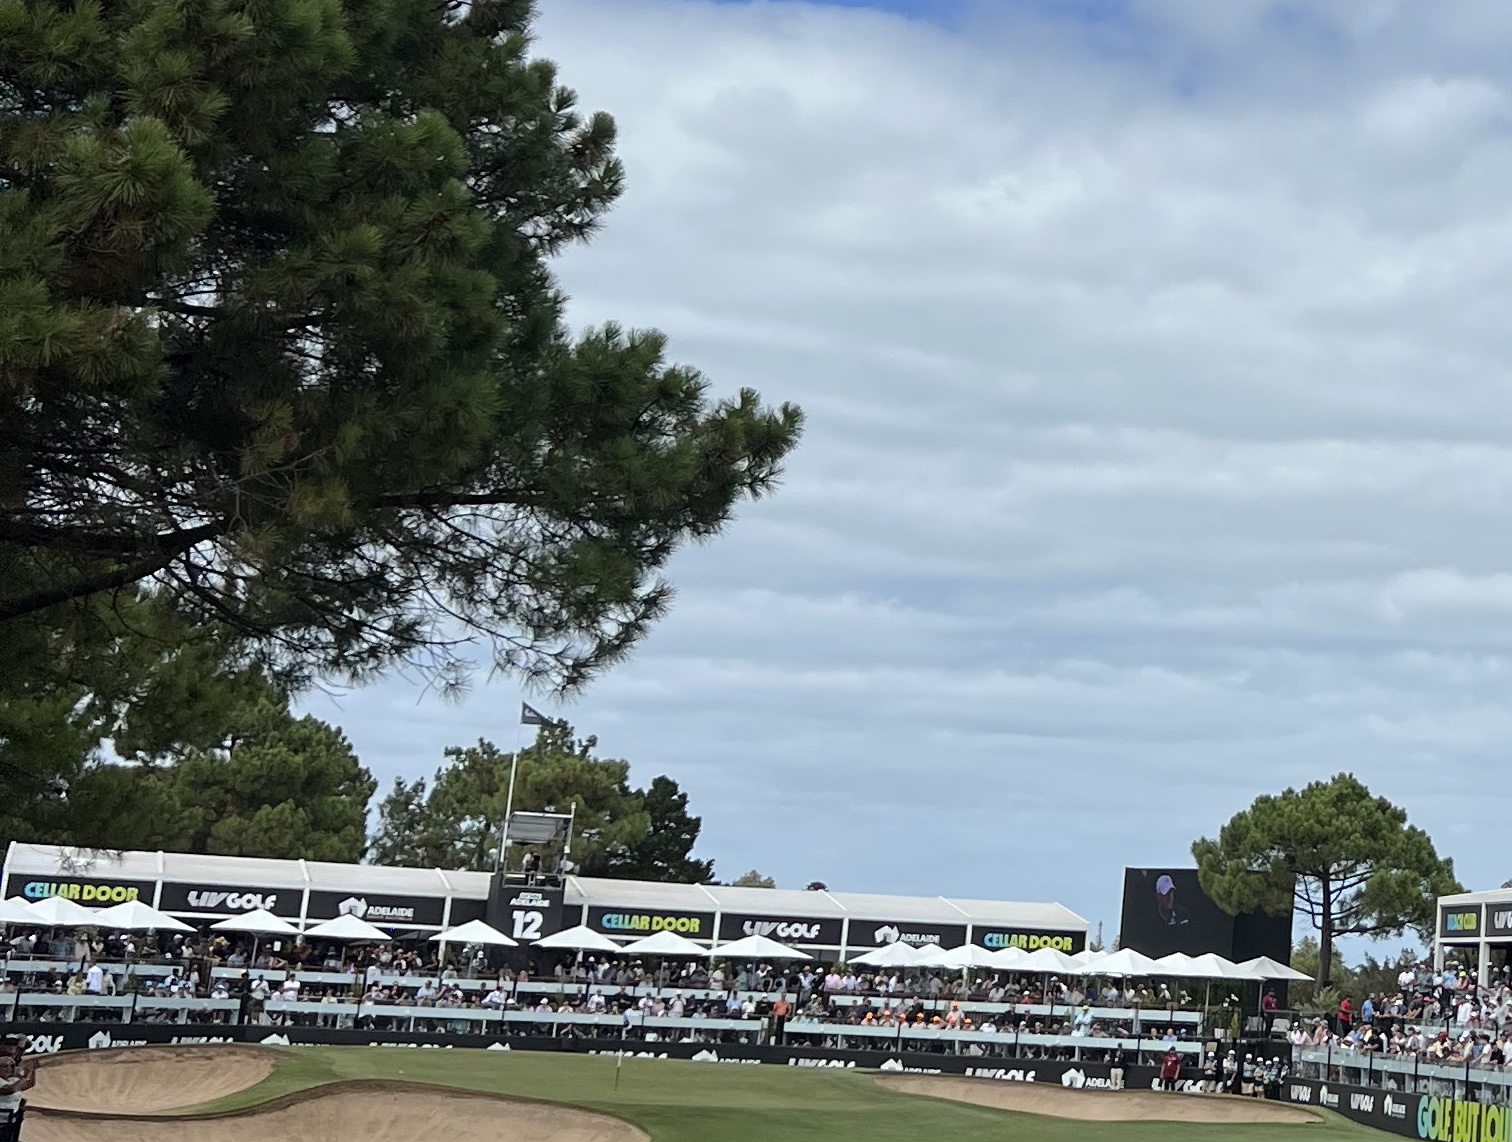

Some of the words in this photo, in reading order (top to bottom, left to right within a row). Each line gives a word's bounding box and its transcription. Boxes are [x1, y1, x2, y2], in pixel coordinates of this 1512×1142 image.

[24, 882, 80, 900] CELLAR
[82, 885, 139, 901] DOOR
[367, 906, 414, 917] ADELAIDE
[512, 910, 543, 940] 12
[601, 914, 650, 931] CELLAR
[651, 916, 701, 933] DOOR
[900, 933, 940, 944] ADELAIDE
[984, 932, 1028, 949] CELLAR
[1029, 935, 1073, 951] DOOR
